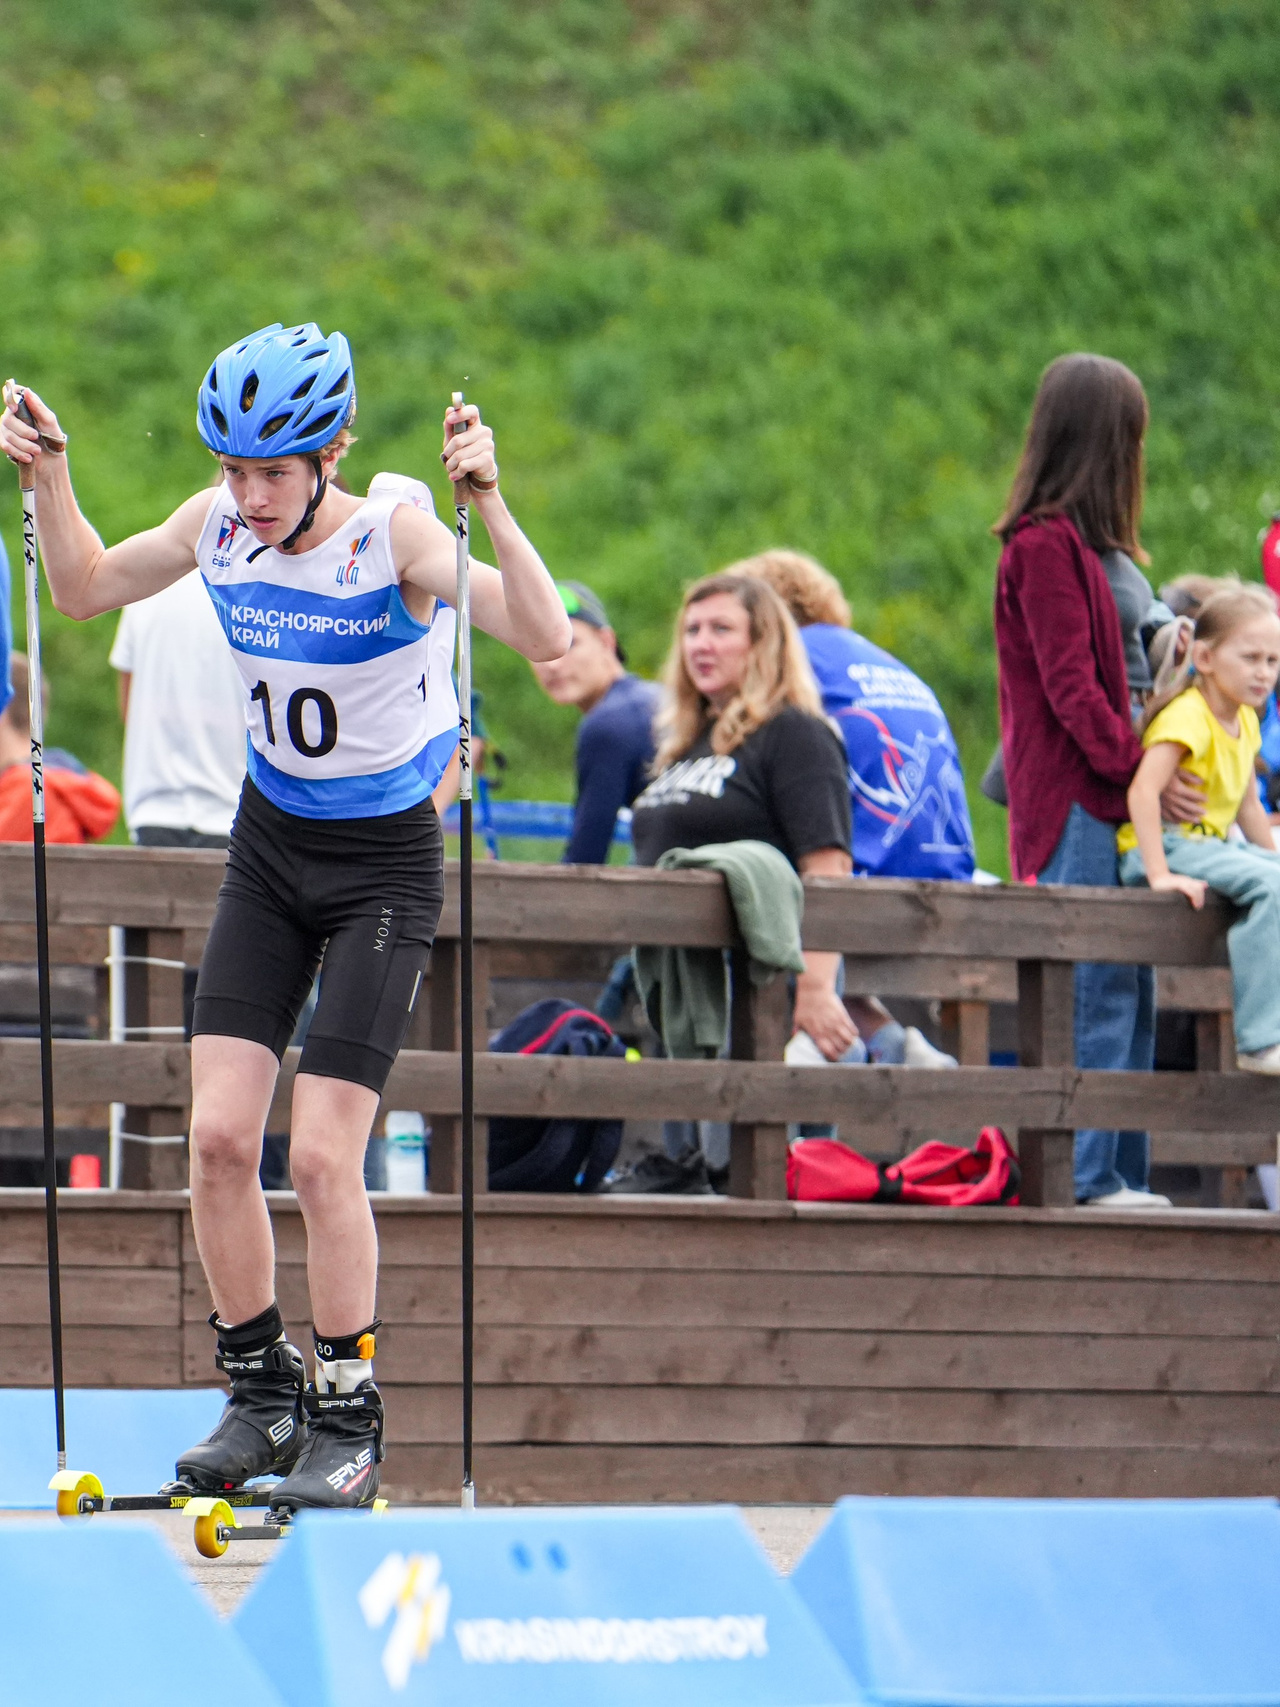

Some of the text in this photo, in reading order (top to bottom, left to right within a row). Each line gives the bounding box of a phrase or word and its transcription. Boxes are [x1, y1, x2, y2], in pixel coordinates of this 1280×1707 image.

[23, 510, 35, 566] KV+
[456, 507, 467, 539] V+
[231, 604, 391, 636] КРАСНОЯРСКИЙ
[231, 625, 280, 649] КРАЙ
[250, 679, 338, 758] 10
[459, 715, 469, 771] KV+
[31, 738, 43, 795] KV+
[373, 906, 393, 952] MOAX
[223, 1360, 263, 1370] SPINE
[315, 1341, 333, 1356] 60
[319, 1397, 365, 1408] SPINE
[326, 1447, 371, 1490] SPINE
